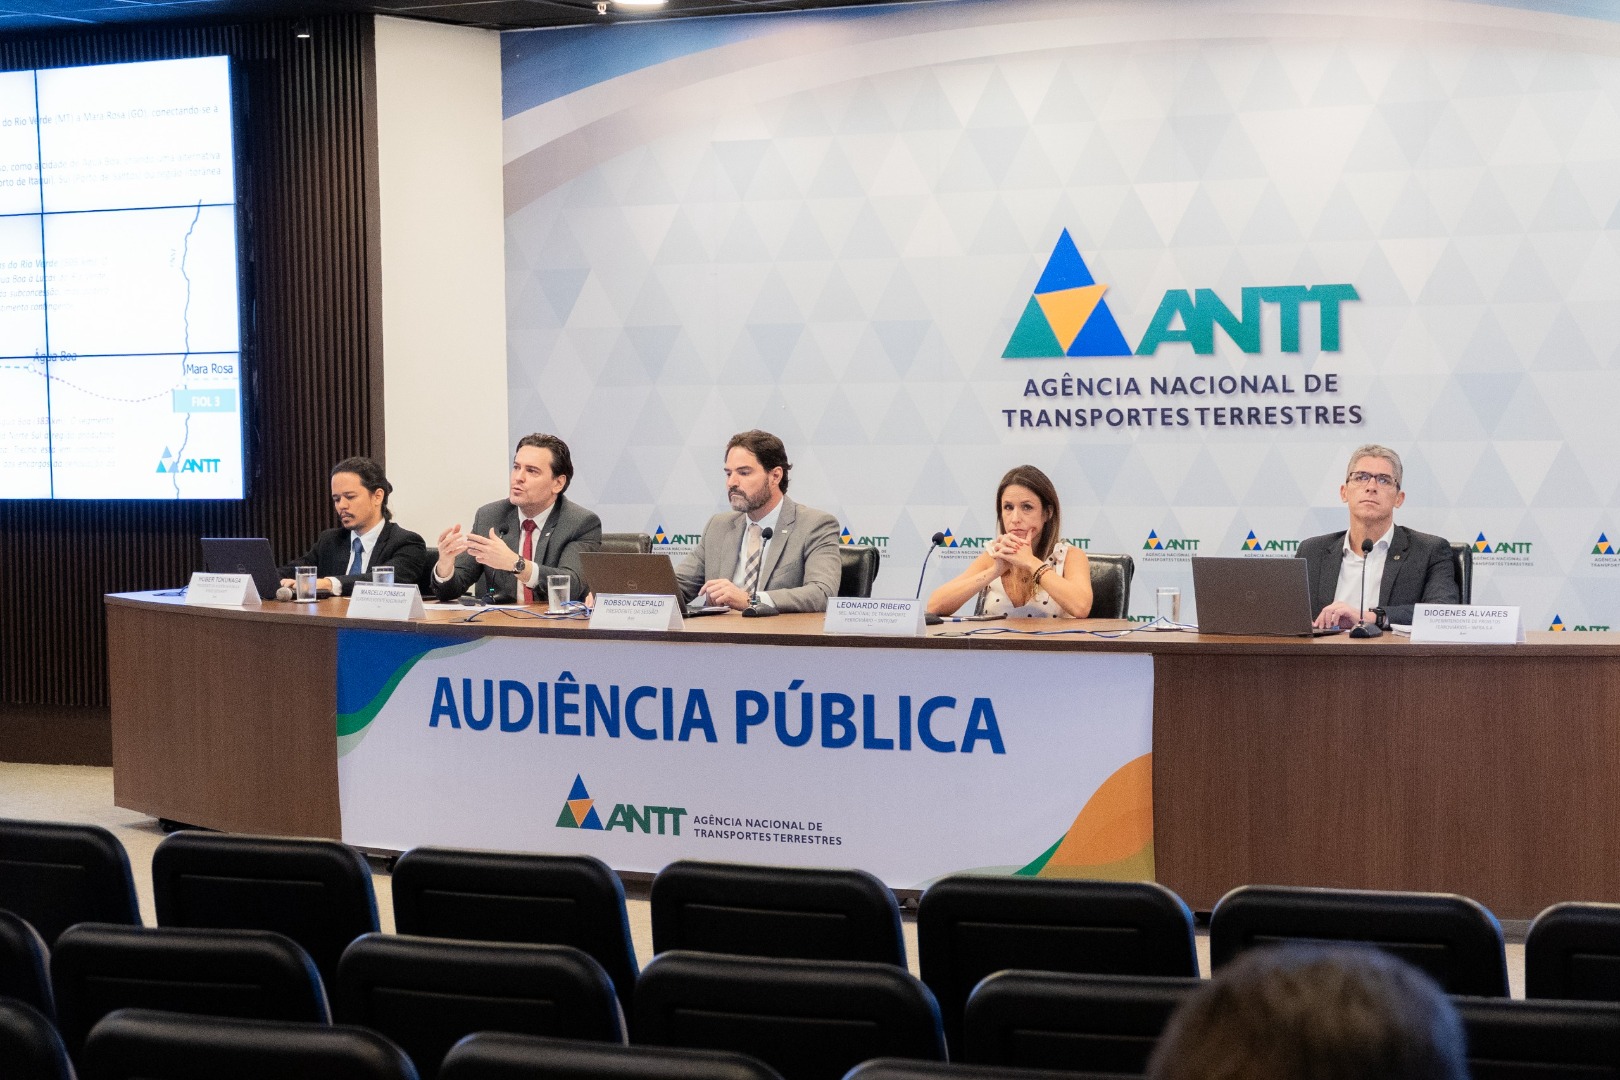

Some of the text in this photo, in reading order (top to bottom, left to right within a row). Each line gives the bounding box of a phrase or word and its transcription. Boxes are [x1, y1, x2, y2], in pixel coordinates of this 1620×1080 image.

[14, 117, 27, 126] Rio
[11, 163, 32, 171] como
[1133, 283, 1362, 356] ANTT
[186, 363, 233, 374] Mara Rosa
[1023, 372, 1338, 397] AGÊNCIA NACIONAL DE
[1002, 405, 1363, 428] TRANSPORTES TERRESTRES
[181, 458, 221, 473] ANTT
[670, 534, 702, 544] ANTT
[858, 536, 890, 547] ANTT
[1066, 539, 1091, 549] NTT
[1165, 539, 1200, 550] ANTT
[1264, 540, 1300, 551] ANTT
[1494, 543, 1532, 553] ANTT
[428, 671, 1006, 755] AUDIÊNCIA PÚBLICA
[604, 803, 688, 836] ANTT
[693, 814, 823, 831] AGÊNCIA NACIONAL DE
[694, 828, 842, 846] TRANSPORTES TERRESTRES
